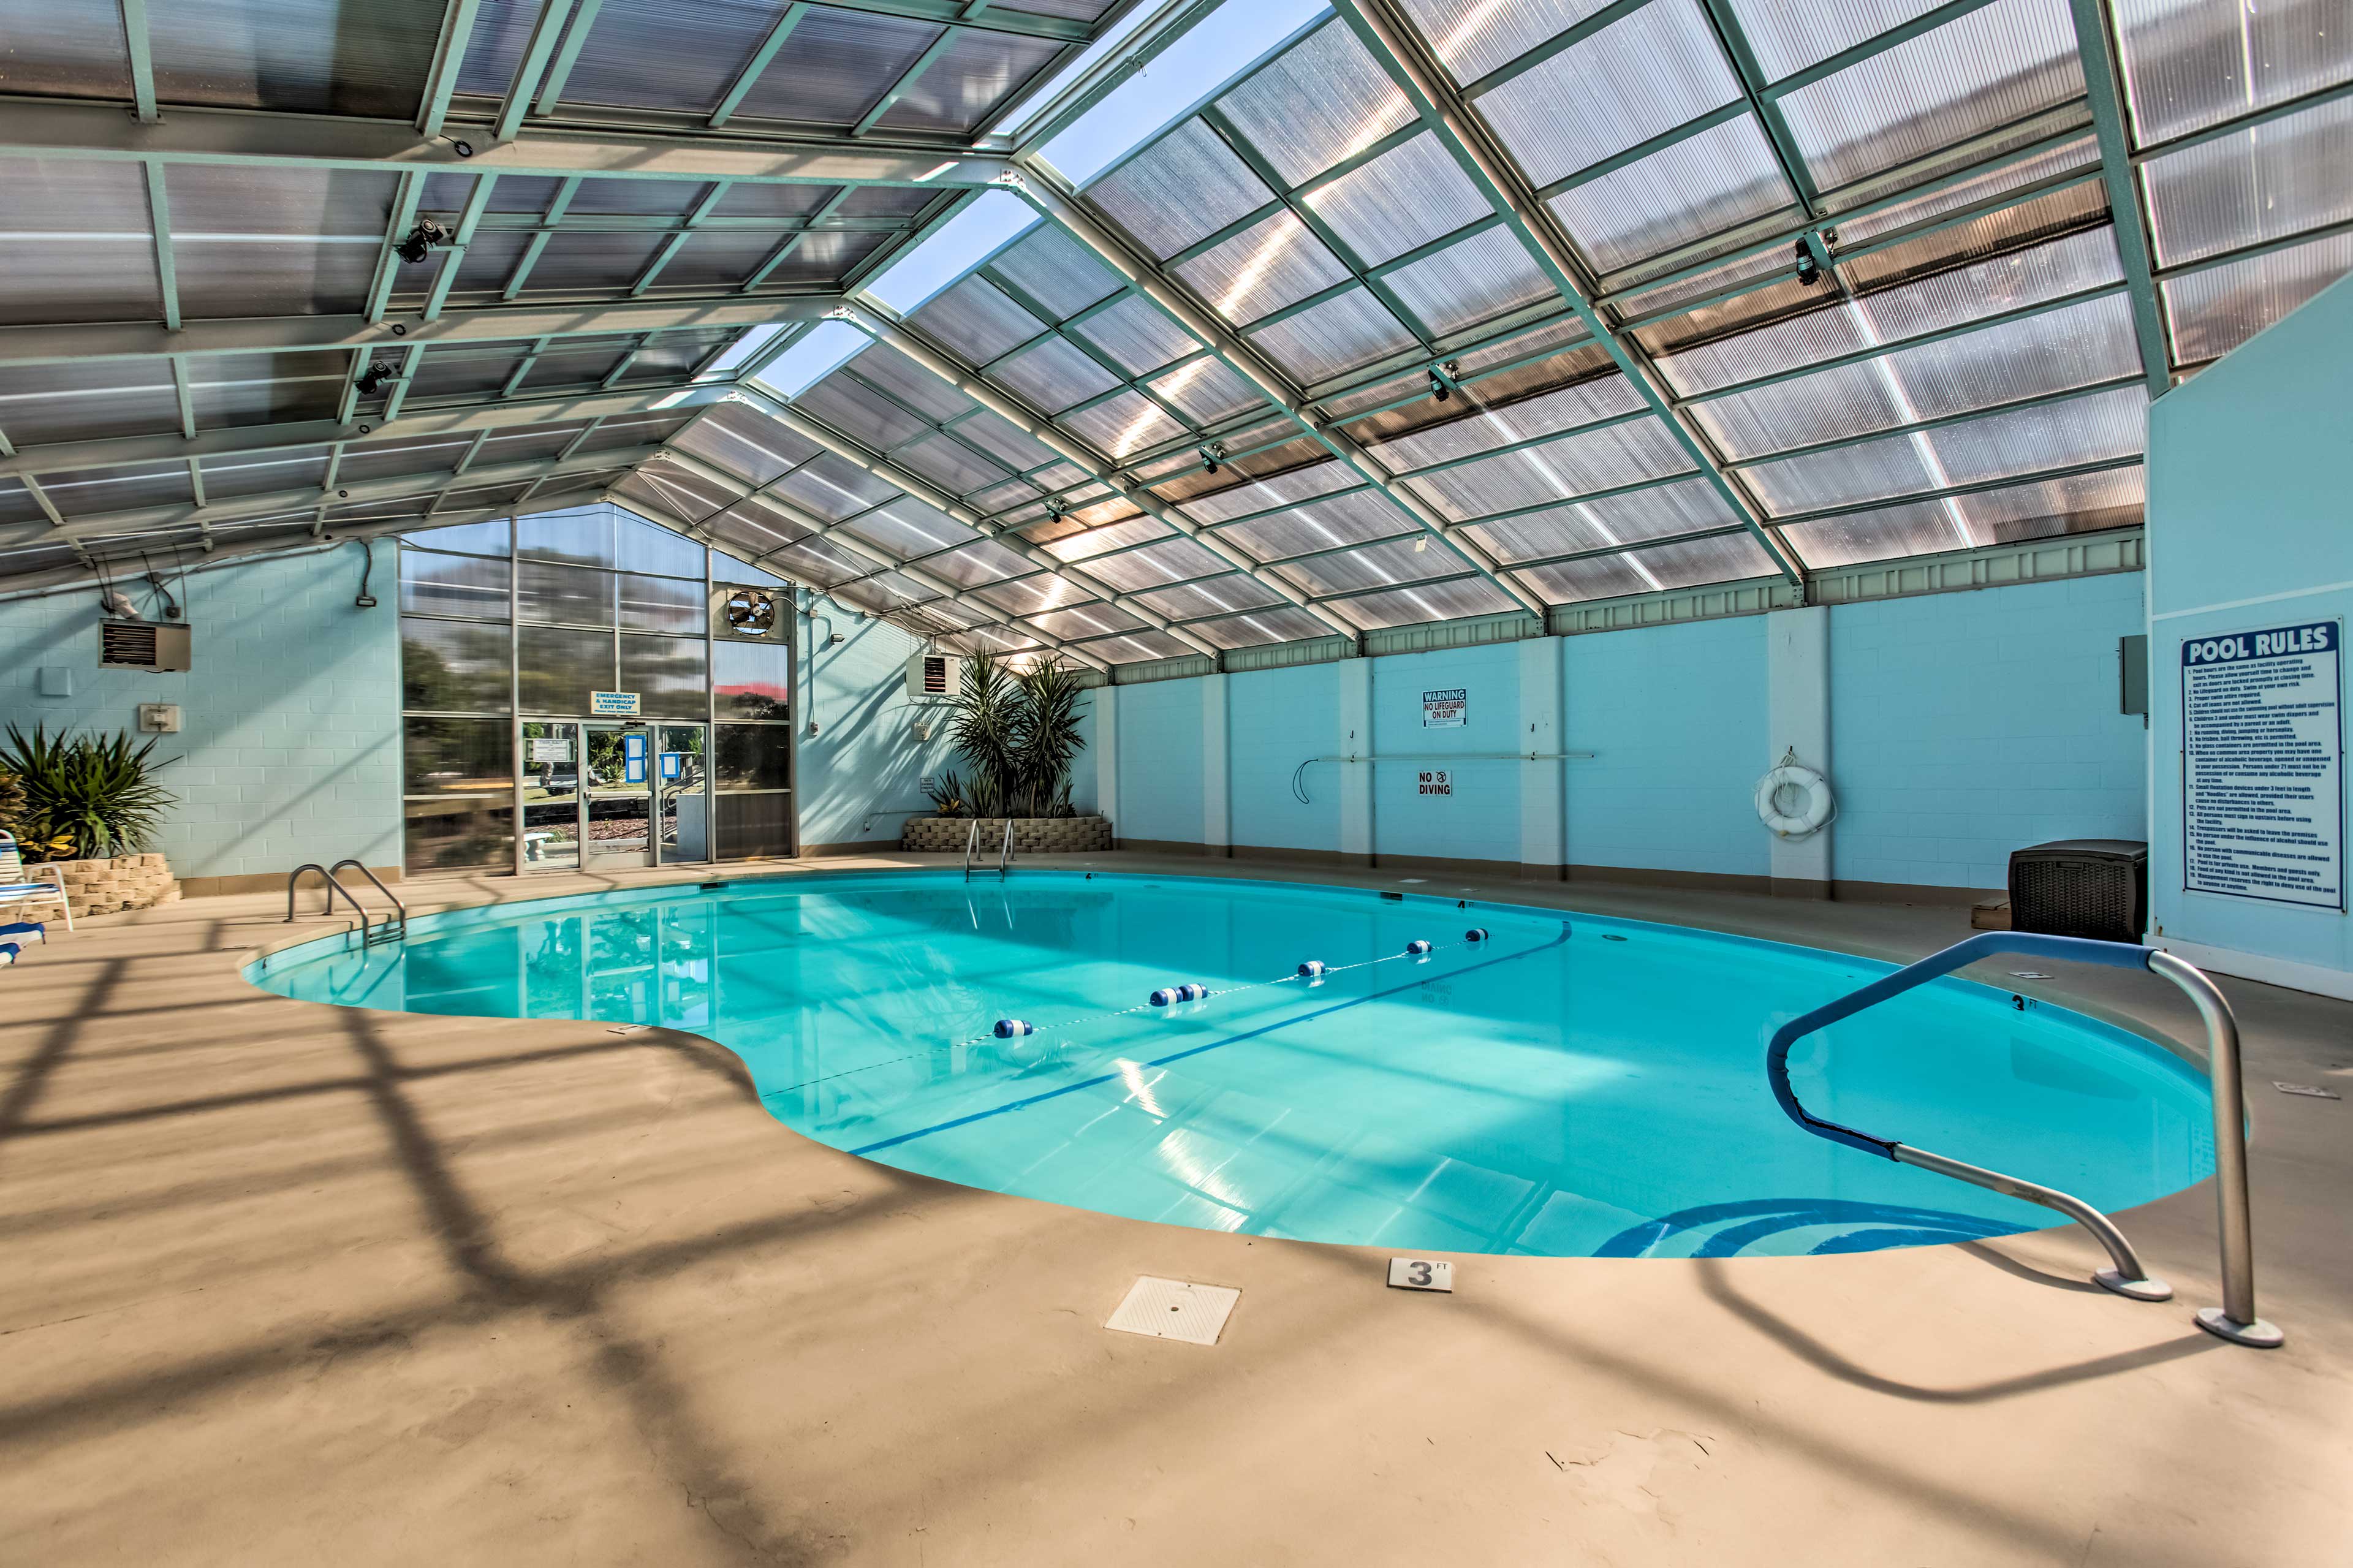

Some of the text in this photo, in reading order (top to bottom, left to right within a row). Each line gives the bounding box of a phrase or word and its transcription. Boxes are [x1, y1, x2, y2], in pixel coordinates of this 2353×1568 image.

[2189, 626, 2328, 663] POOL RULES
[1425, 690, 1464, 701] WARNING
[1435, 701, 1464, 710] LIFEGUARD
[1419, 773, 1431, 782] NO
[1419, 785, 1450, 794] DIVING
[2233, 848, 2270, 857] communicable
[2012, 994, 2037, 1010] 3 FT
[1408, 1261, 1432, 1286] 3
